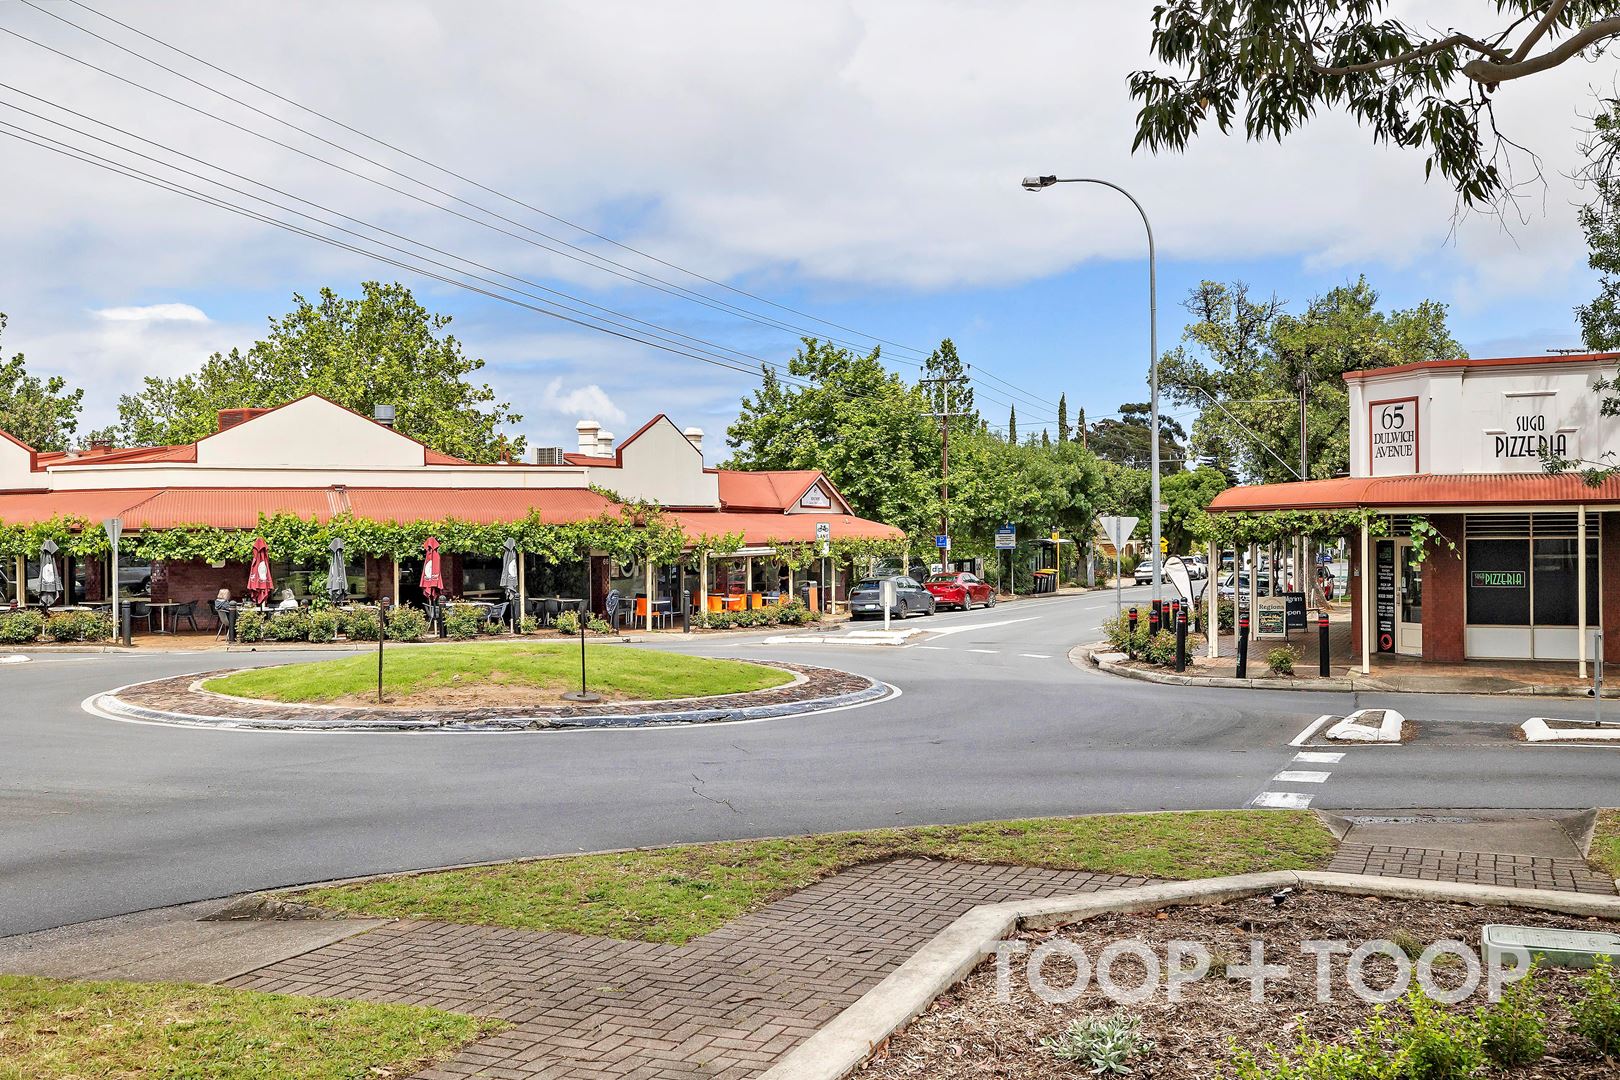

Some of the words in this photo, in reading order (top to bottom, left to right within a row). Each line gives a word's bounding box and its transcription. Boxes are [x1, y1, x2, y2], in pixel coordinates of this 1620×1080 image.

[1382, 404, 1404, 430] 65
[1516, 415, 1545, 431] SUGO
[1374, 431, 1414, 444] DULWICH
[1375, 445, 1413, 458] AVENUE
[1485, 573, 1522, 585] PIZZERIA
